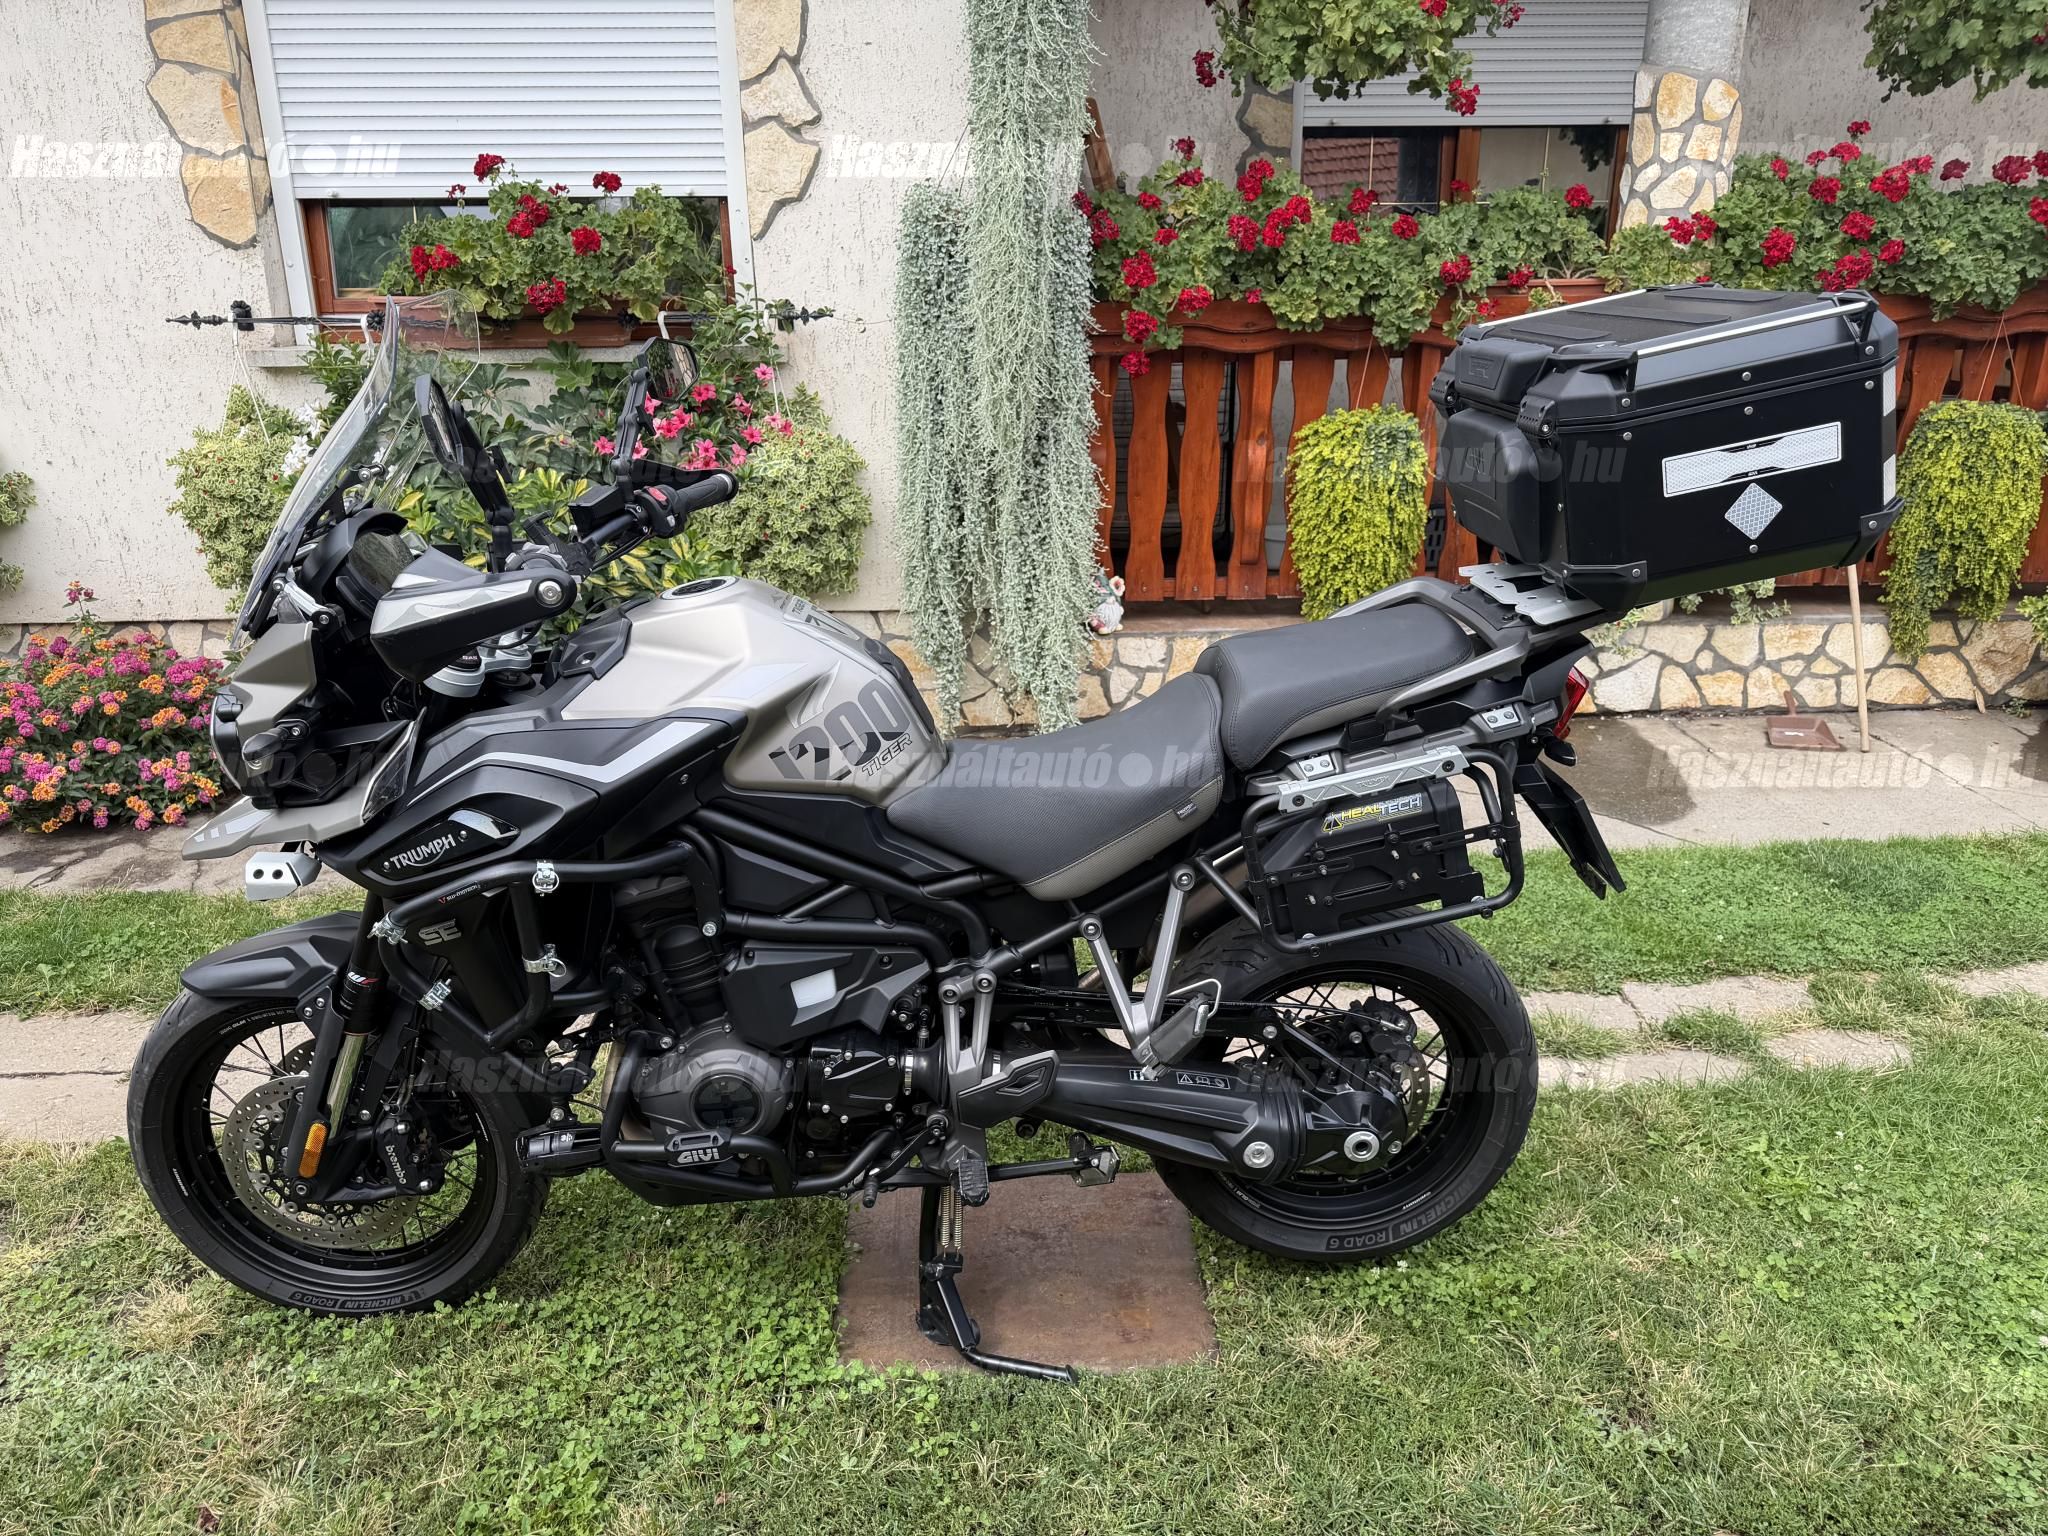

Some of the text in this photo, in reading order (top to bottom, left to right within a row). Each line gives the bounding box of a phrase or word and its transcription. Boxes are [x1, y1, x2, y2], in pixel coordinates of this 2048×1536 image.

[768, 678, 911, 781] 1200
[861, 733, 913, 777] TIGER
[1341, 794, 1422, 820] HEALTECH
[390, 833, 457, 870] TRIUMPH
[418, 917, 462, 946] SE
[385, 1144, 407, 1185] brembo
[677, 1147, 720, 1164] GIVI
[1399, 1180, 1475, 1236] MICHELIN
[1328, 1238, 1340, 1249] 6
[1343, 1231, 1387, 1248] ROAD
[292, 1292, 402, 1310] MICHELIN ROAD 6
